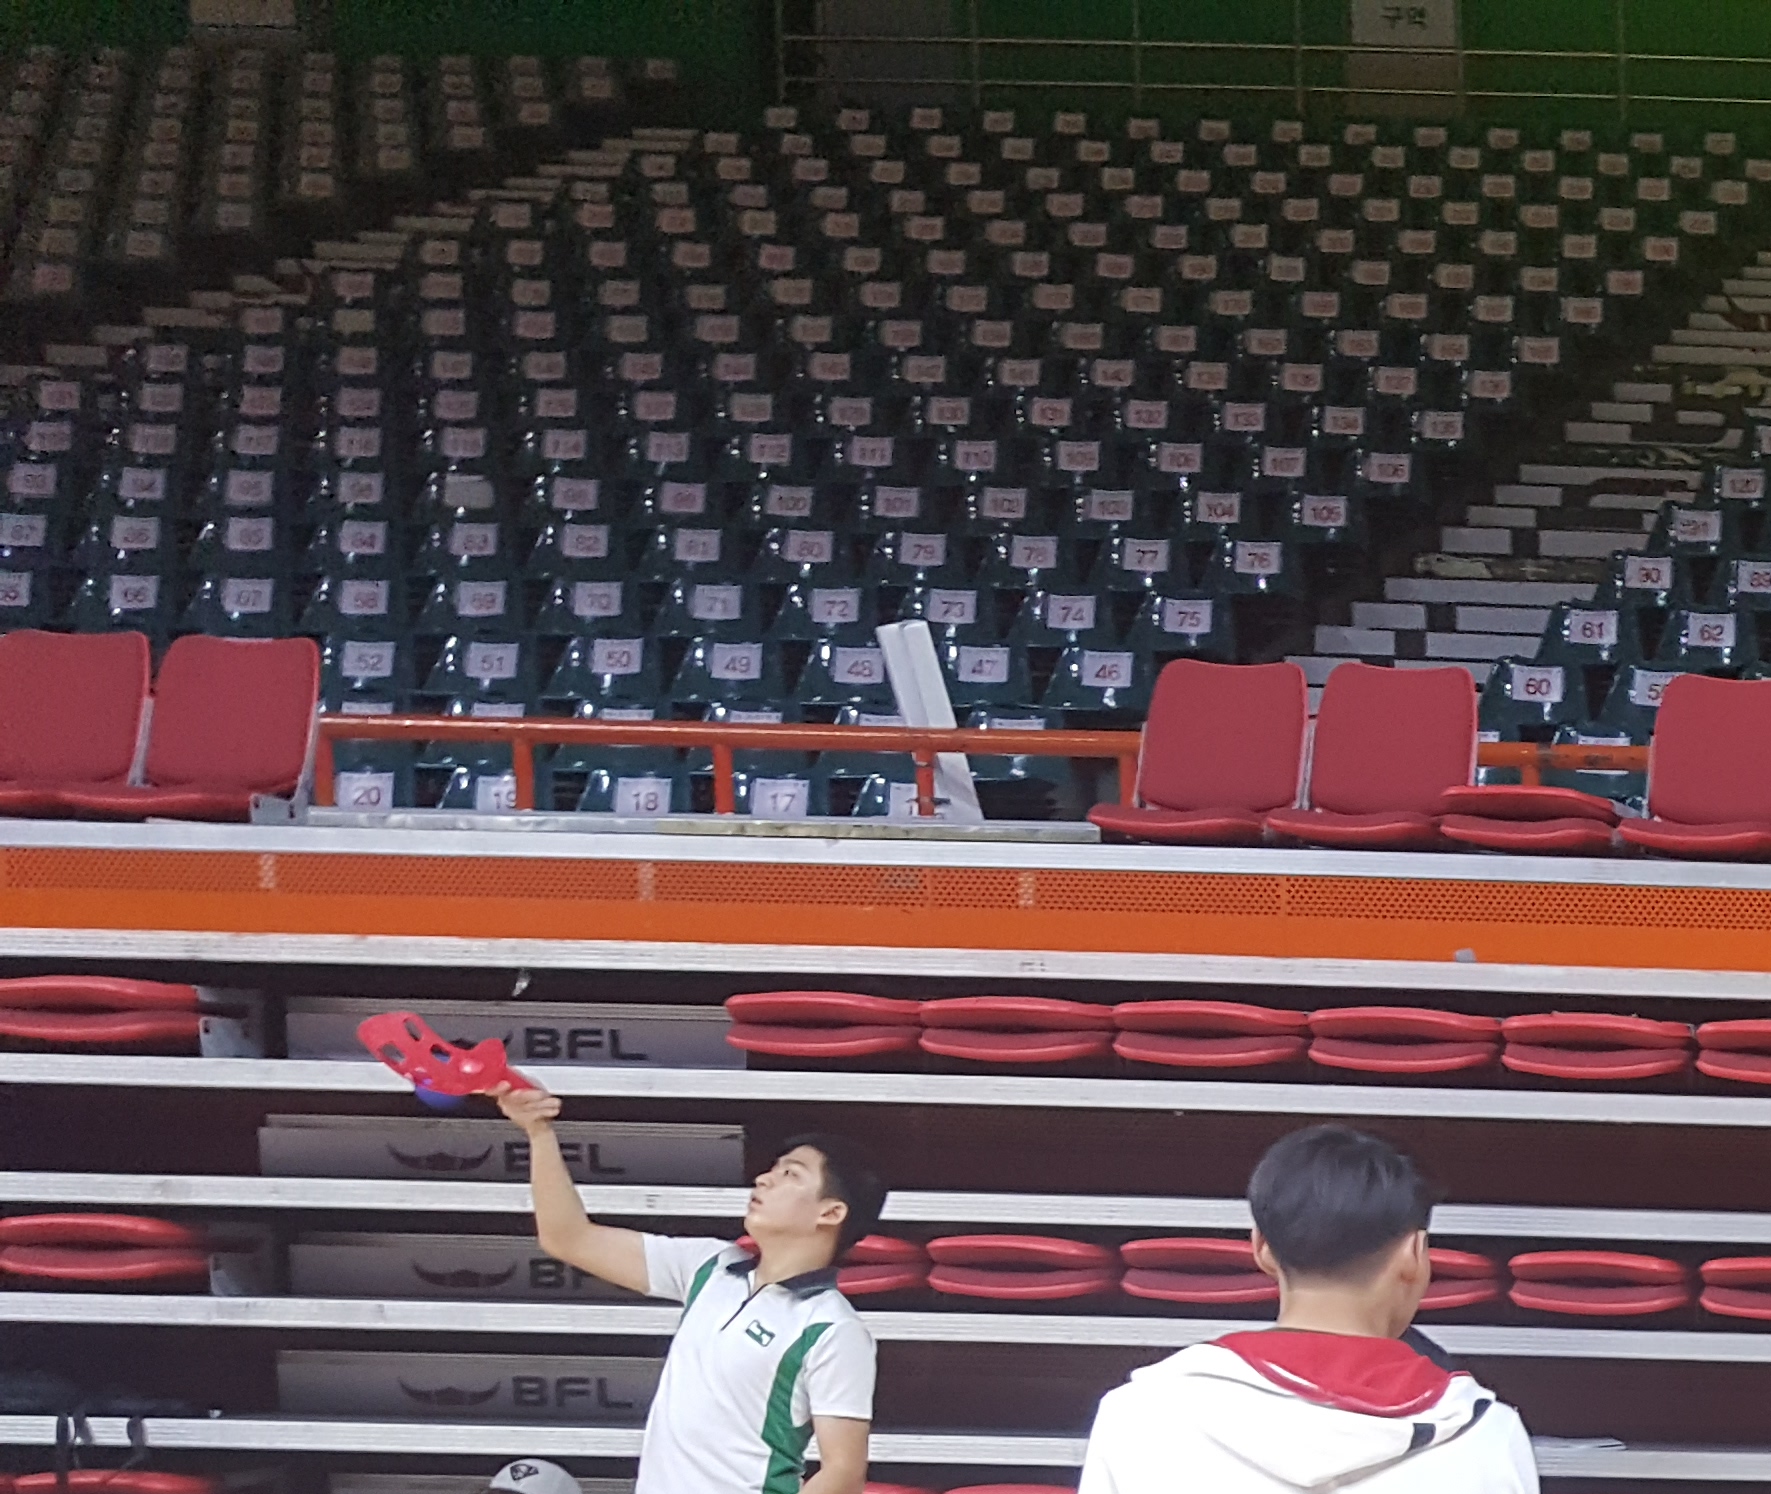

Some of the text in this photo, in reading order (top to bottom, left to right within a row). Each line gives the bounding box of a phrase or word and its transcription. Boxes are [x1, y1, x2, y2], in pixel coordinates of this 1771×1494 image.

[1060, 605, 1084, 623] 74
[1581, 621, 1603, 638] 61
[1699, 624, 1724, 642] 62
[724, 656, 751, 673] 49
[1525, 677, 1551, 695] 60
[632, 792, 659, 815] 18
[524, 1027, 648, 1060] BFL
[512, 1376, 633, 1408] BFL
